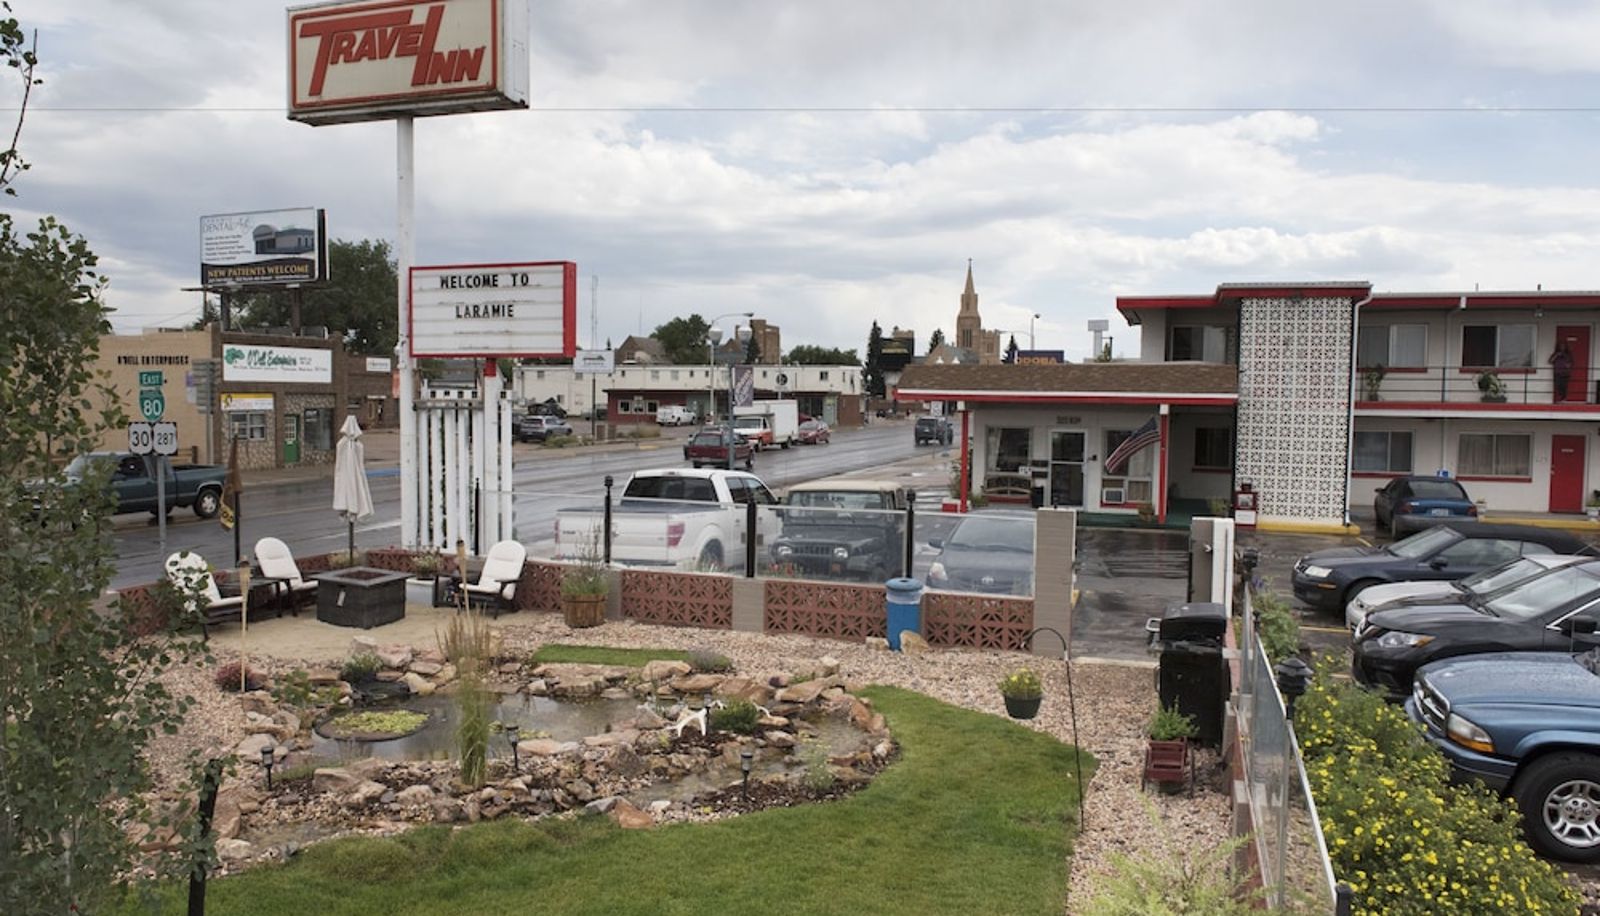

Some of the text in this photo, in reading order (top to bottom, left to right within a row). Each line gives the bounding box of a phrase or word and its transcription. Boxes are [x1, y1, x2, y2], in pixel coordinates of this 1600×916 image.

[411, 5, 486, 87] INN
[207, 264, 309, 278] NEW PATIENTS WELCOME
[440, 273, 529, 289] WELCOME TO
[456, 304, 514, 318] LARAMIE
[142, 373, 161, 385] EAST
[143, 400, 163, 416] 80
[132, 431, 150, 447] 30
[156, 433, 174, 446] 287
